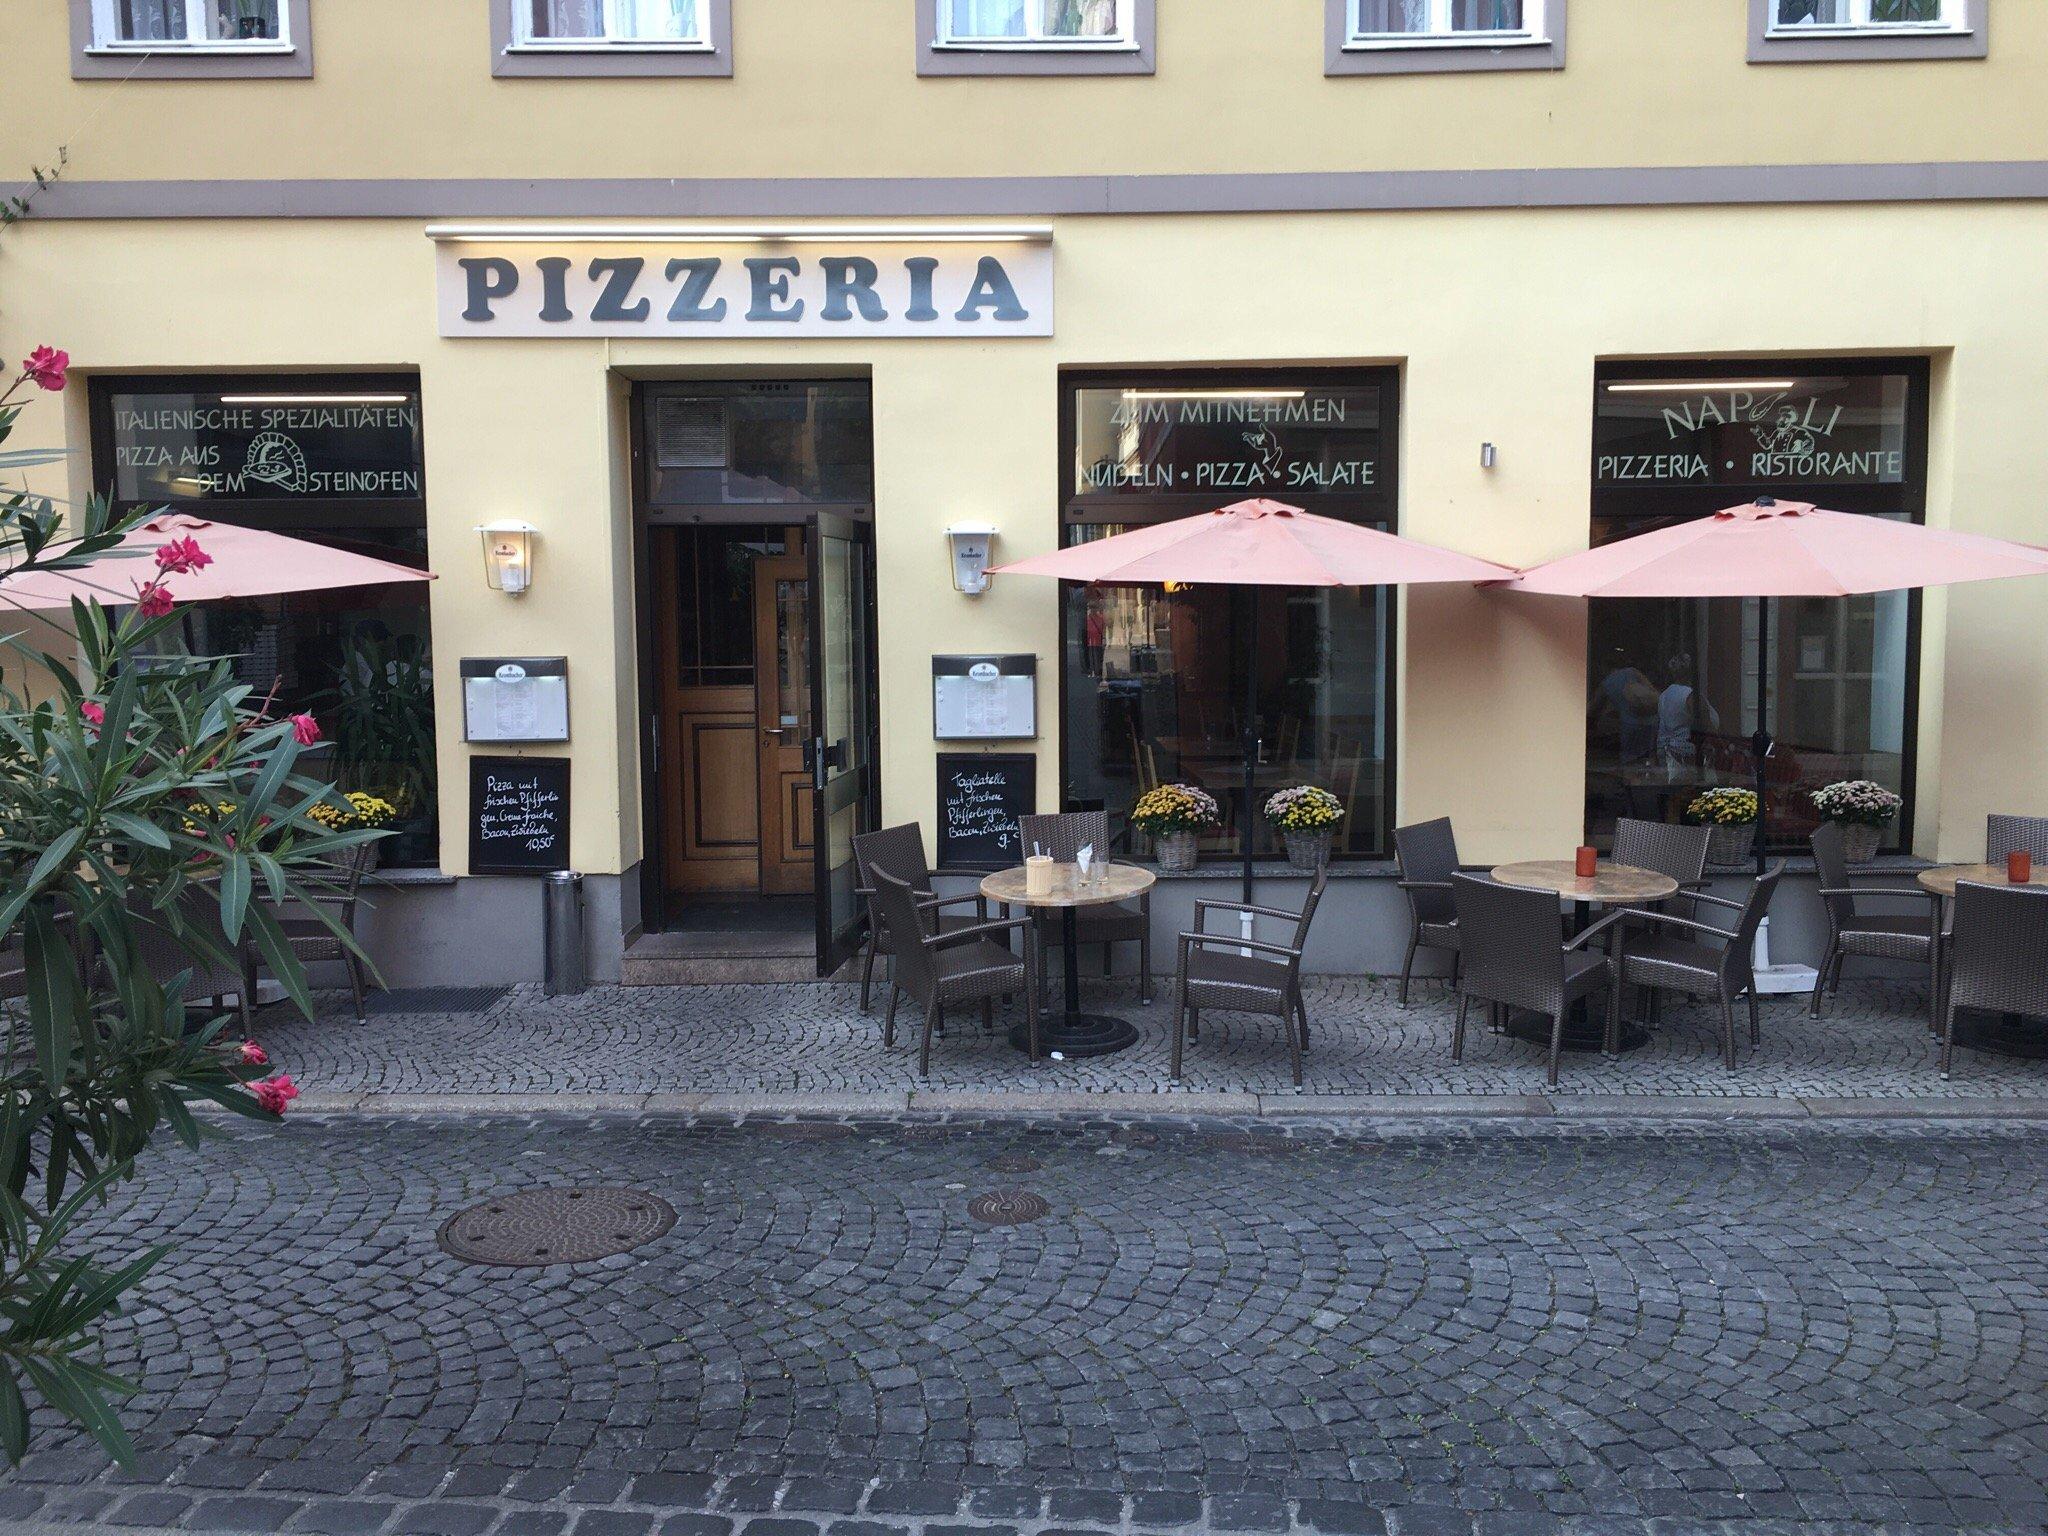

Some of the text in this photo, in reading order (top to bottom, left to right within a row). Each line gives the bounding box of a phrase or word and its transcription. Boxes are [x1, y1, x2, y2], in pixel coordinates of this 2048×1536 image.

[457, 255, 1029, 323] PIZZERIA
[115, 403, 415, 430] ITALIENISCHE SPEZIALITÄTEN
[1109, 398, 1346, 424] ZUM MITNEHMEN
[116, 445, 220, 466] PIZZA AUS
[1598, 451, 1900, 479] PIZZERIA RISTORANTE
[197, 471, 418, 493] DEM STEINOFEN
[1079, 461, 1375, 487] NUDELN PIZZA SALATE
[487, 775, 538, 792] Pizza mit
[951, 771, 1006, 793] Tagliatelle
[947, 791, 964, 806] mit
